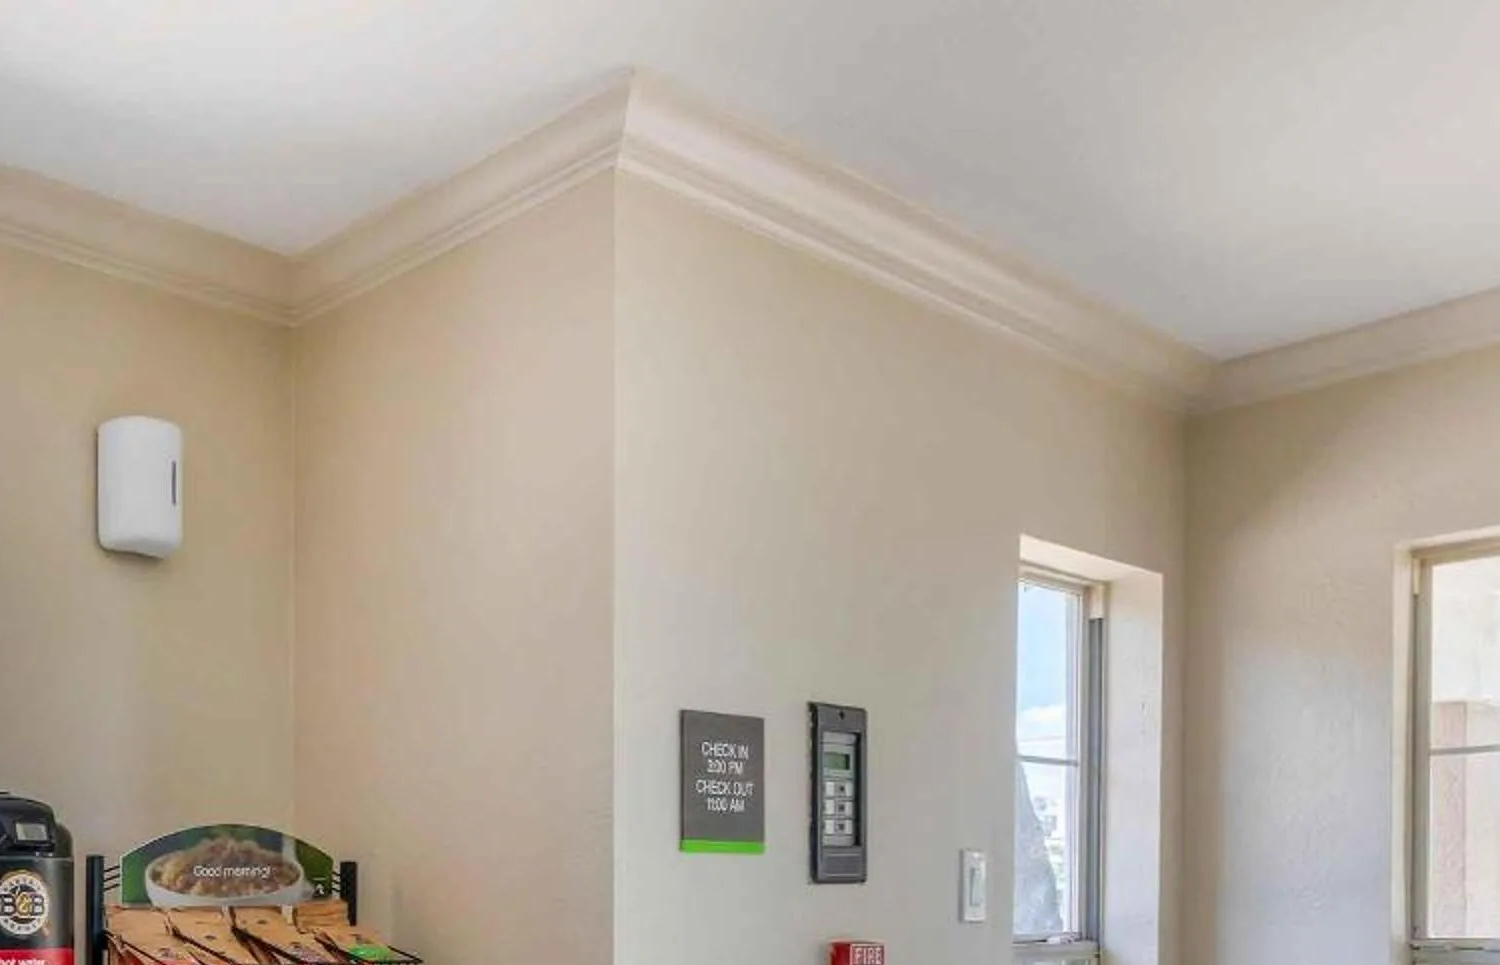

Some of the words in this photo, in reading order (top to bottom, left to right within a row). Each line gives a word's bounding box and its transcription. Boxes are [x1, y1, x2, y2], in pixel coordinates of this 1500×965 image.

[701, 742, 736, 758] CHECK
[738, 744, 749, 759] IN
[728, 761, 743, 774] PM
[696, 780, 731, 795] CHECK
[733, 782, 754, 797] OUT
[730, 798, 745, 812] AM
[193, 865, 221, 877] Good
[855, 947, 882, 965] FIRE
